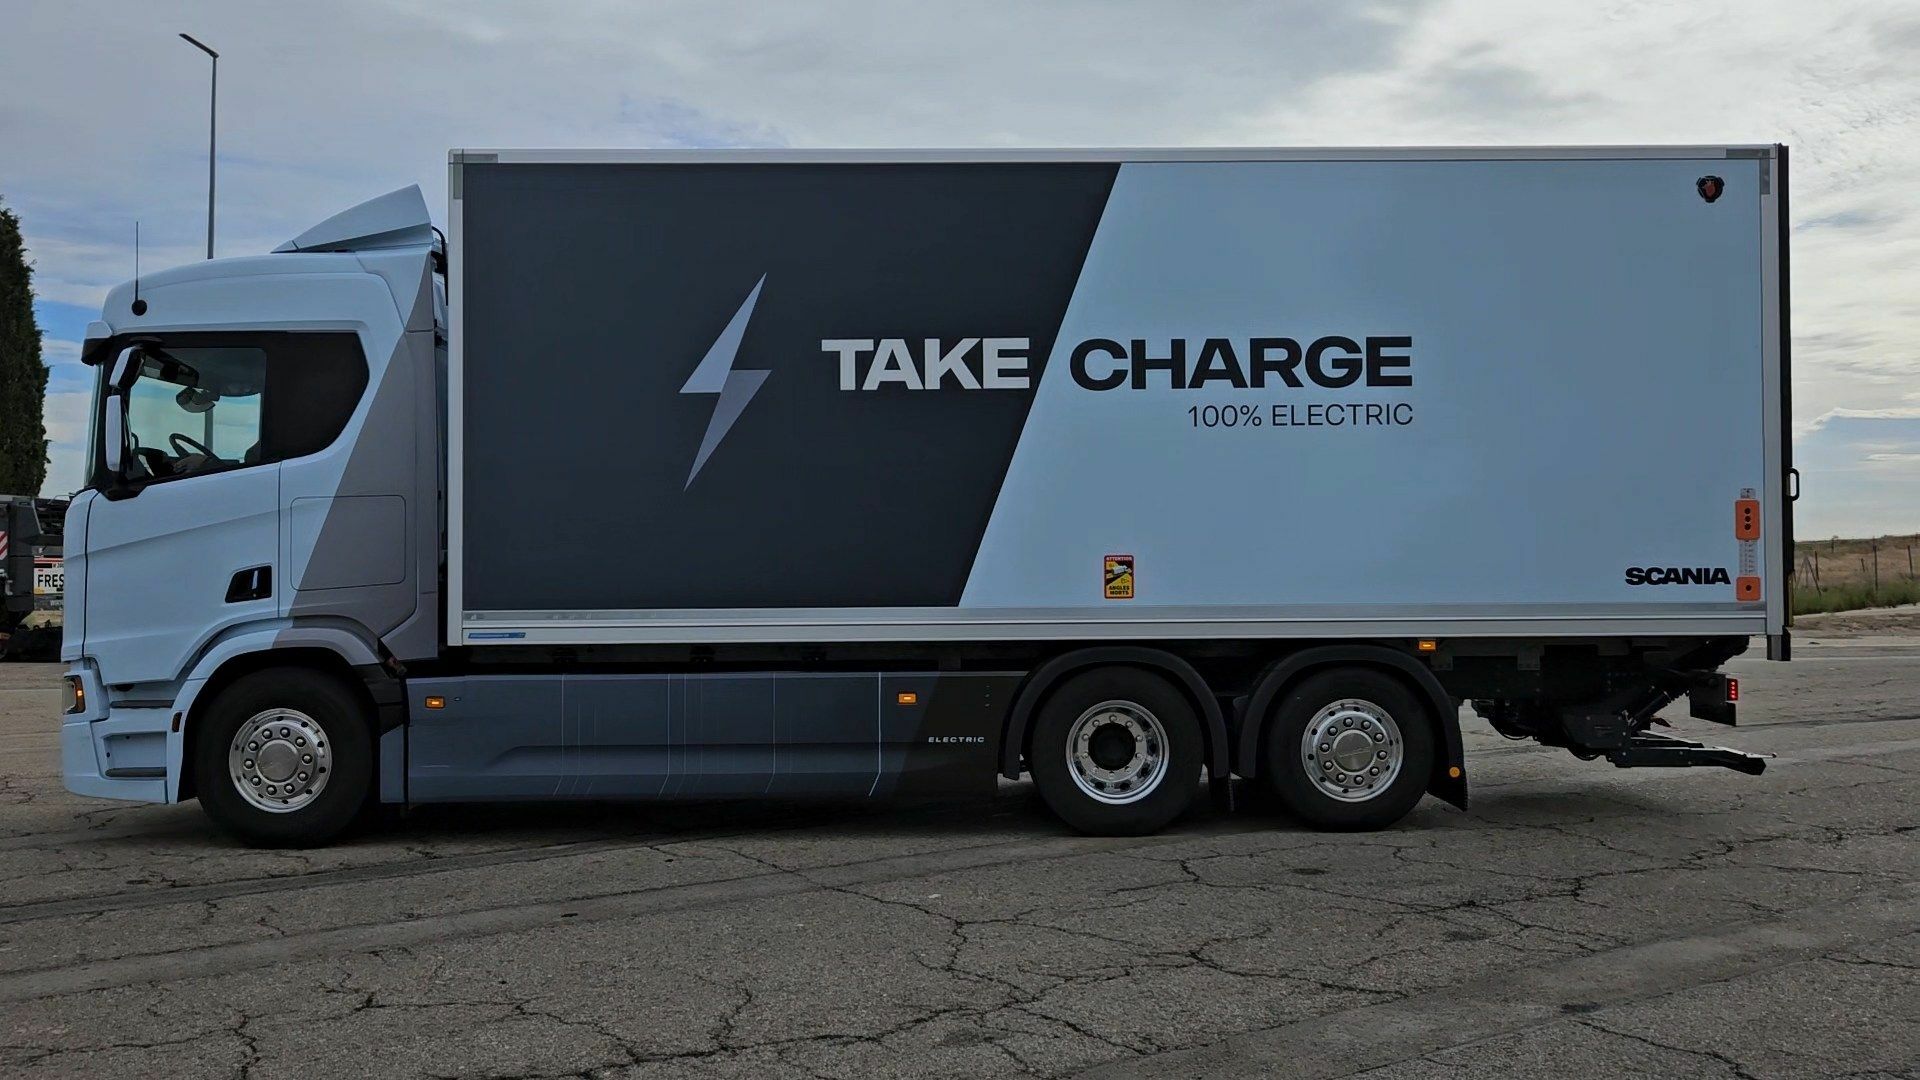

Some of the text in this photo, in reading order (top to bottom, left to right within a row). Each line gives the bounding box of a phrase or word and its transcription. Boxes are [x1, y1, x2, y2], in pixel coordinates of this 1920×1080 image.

[821, 335, 1413, 391] TAKE CHARGE
[1188, 402, 1414, 428] 100% ELECTRIC
[1625, 566, 1731, 586] SCANIA
